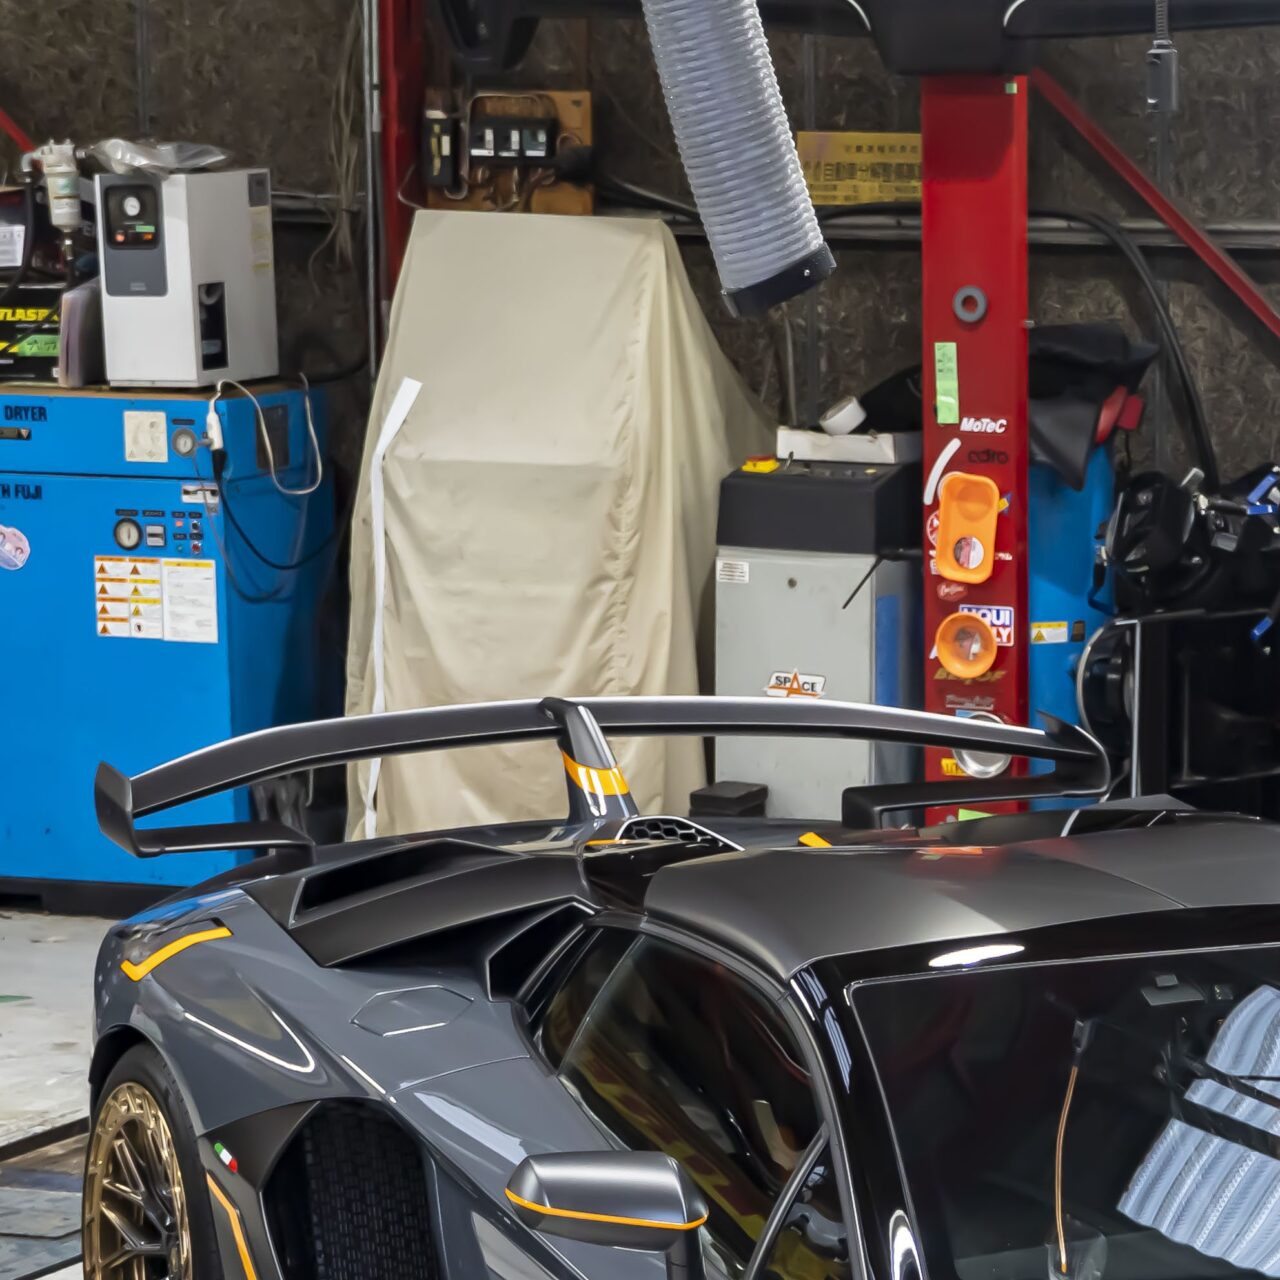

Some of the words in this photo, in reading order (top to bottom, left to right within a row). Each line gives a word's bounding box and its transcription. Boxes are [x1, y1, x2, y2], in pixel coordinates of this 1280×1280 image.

[4, 405, 48, 421] DRYER
[960, 417, 1007, 433] MoTeC
[14, 483, 42, 500] FUJI
[961, 607, 1011, 626] QUI
[774, 672, 818, 693] SPACE
